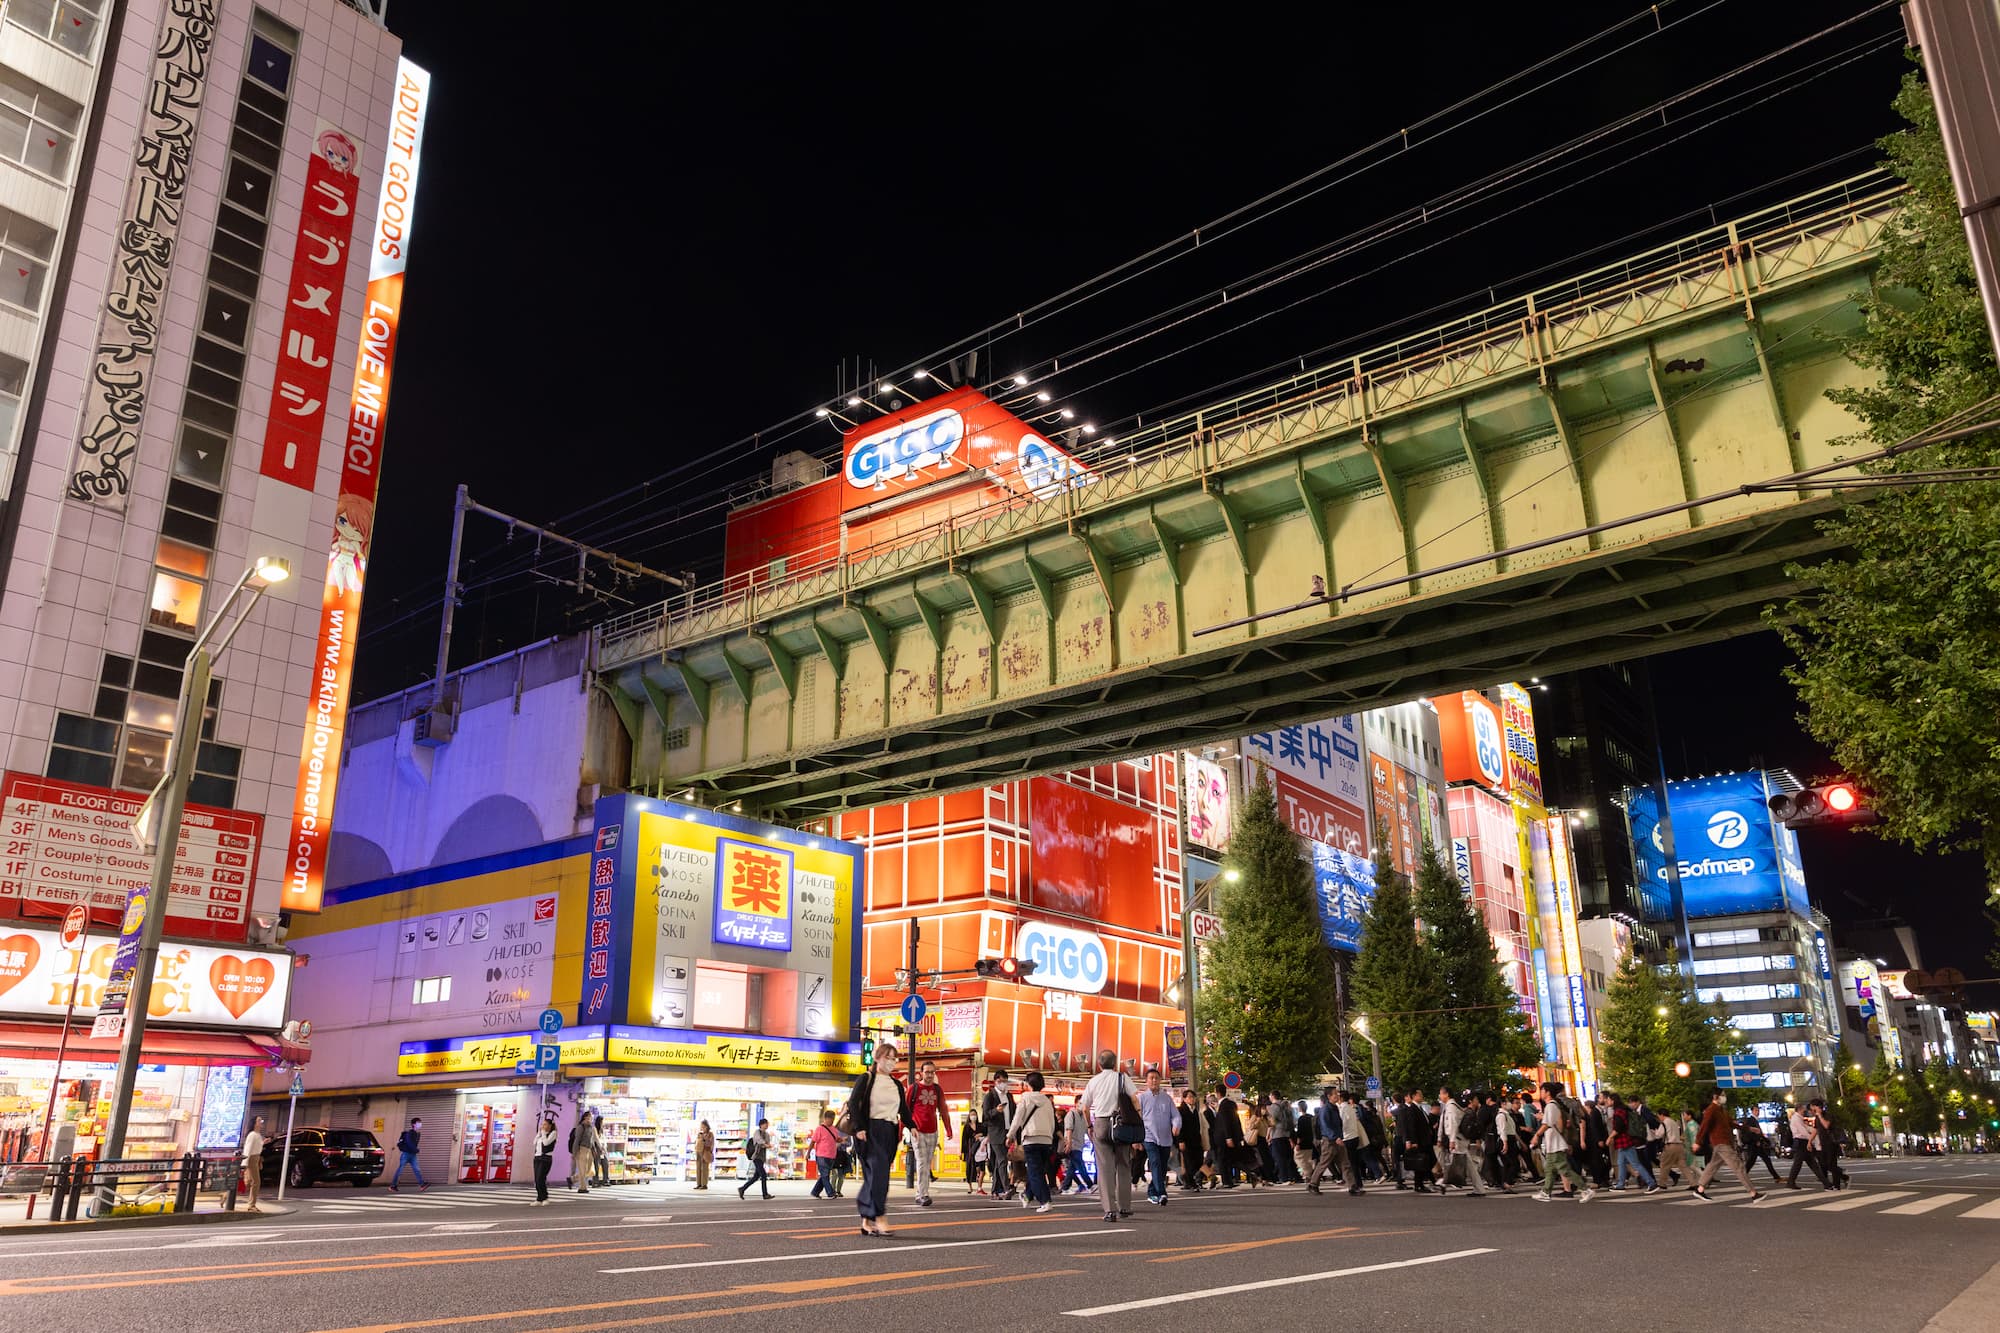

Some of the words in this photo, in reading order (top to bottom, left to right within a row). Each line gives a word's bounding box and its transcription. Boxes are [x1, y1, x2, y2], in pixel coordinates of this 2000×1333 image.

[391, 72, 422, 157] ADULT
[379, 161, 410, 261] GOODS
[280, 179, 351, 470] ラブメルシー
[363, 299, 395, 387] LOVE
[347, 384, 379, 475] MERCI
[290, 609, 345, 894] www.akibalovemerci.com
[1374, 762, 1386, 785] 4F
[15, 803, 40, 817] 4F
[51, 808, 89, 825] Men's
[60, 792, 108, 810] FLOOR
[110, 801, 143, 816] GUID
[1283, 793, 1321, 838] Tax
[1324, 812, 1363, 857] Free
[11, 822, 35, 836] 3F
[47, 827, 86, 843] Men's
[90, 833, 133, 850] Goods
[229, 838, 246, 848] Only
[7, 841, 32, 856] 2F
[43, 847, 104, 865] Couple's
[107, 855, 150, 871] Goods
[227, 855, 243, 866] Only
[648, 845, 709, 868] SHISEIDO
[5, 861, 28, 875] 1F
[40, 866, 103, 884] Costume
[230, 874, 242, 883] OK
[671, 870, 703, 885] KOSÉ
[1678, 856, 1756, 880] Sofmap
[1, 880, 23, 895] B1
[36, 885, 80, 902] Fetish
[731, 849, 782, 914] 薬
[797, 873, 848, 893] SHISEIDO
[227, 892, 239, 900] OK
[651, 884, 700, 903] Kanebo
[225, 910, 237, 919] OK
[653, 903, 697, 922] SOFINA
[736, 912, 755, 923] DRUG
[755, 914, 773, 925] STORE
[801, 909, 841, 926] Kanebo
[720, 919, 787, 945] マツモトキヨシ
[803, 927, 839, 943] SOFINA
[1194, 914, 1220, 939] GPS
[483, 941, 543, 963] SHISEIDO
[1024, 931, 1104, 983] GiGO
[223, 974, 240, 983] OPEN
[244, 975, 265, 984] 10:00
[503, 963, 536, 980] KOSÉ
[217, 983, 238, 992] CLOSE
[242, 985, 263, 994] 22:00
[485, 987, 531, 1006] Kanebo
[482, 1008, 523, 1029] SOFINA
[944, 1006, 980, 1016] ギフトカード
[543, 1014, 554, 1030] P
[550, 1023, 558, 1031] 60
[469, 1044, 522, 1065] マツモトキヨシ
[541, 1047, 557, 1068] P
[623, 1045, 675, 1058] Matsumoto
[674, 1047, 706, 1060] KiYoshi
[717, 1043, 781, 1065] マツモトキヨシ
[790, 1055, 831, 1068] Matsumoto
[830, 1058, 858, 1069] KiYoshi
[406, 1057, 438, 1070] Matsumoto
